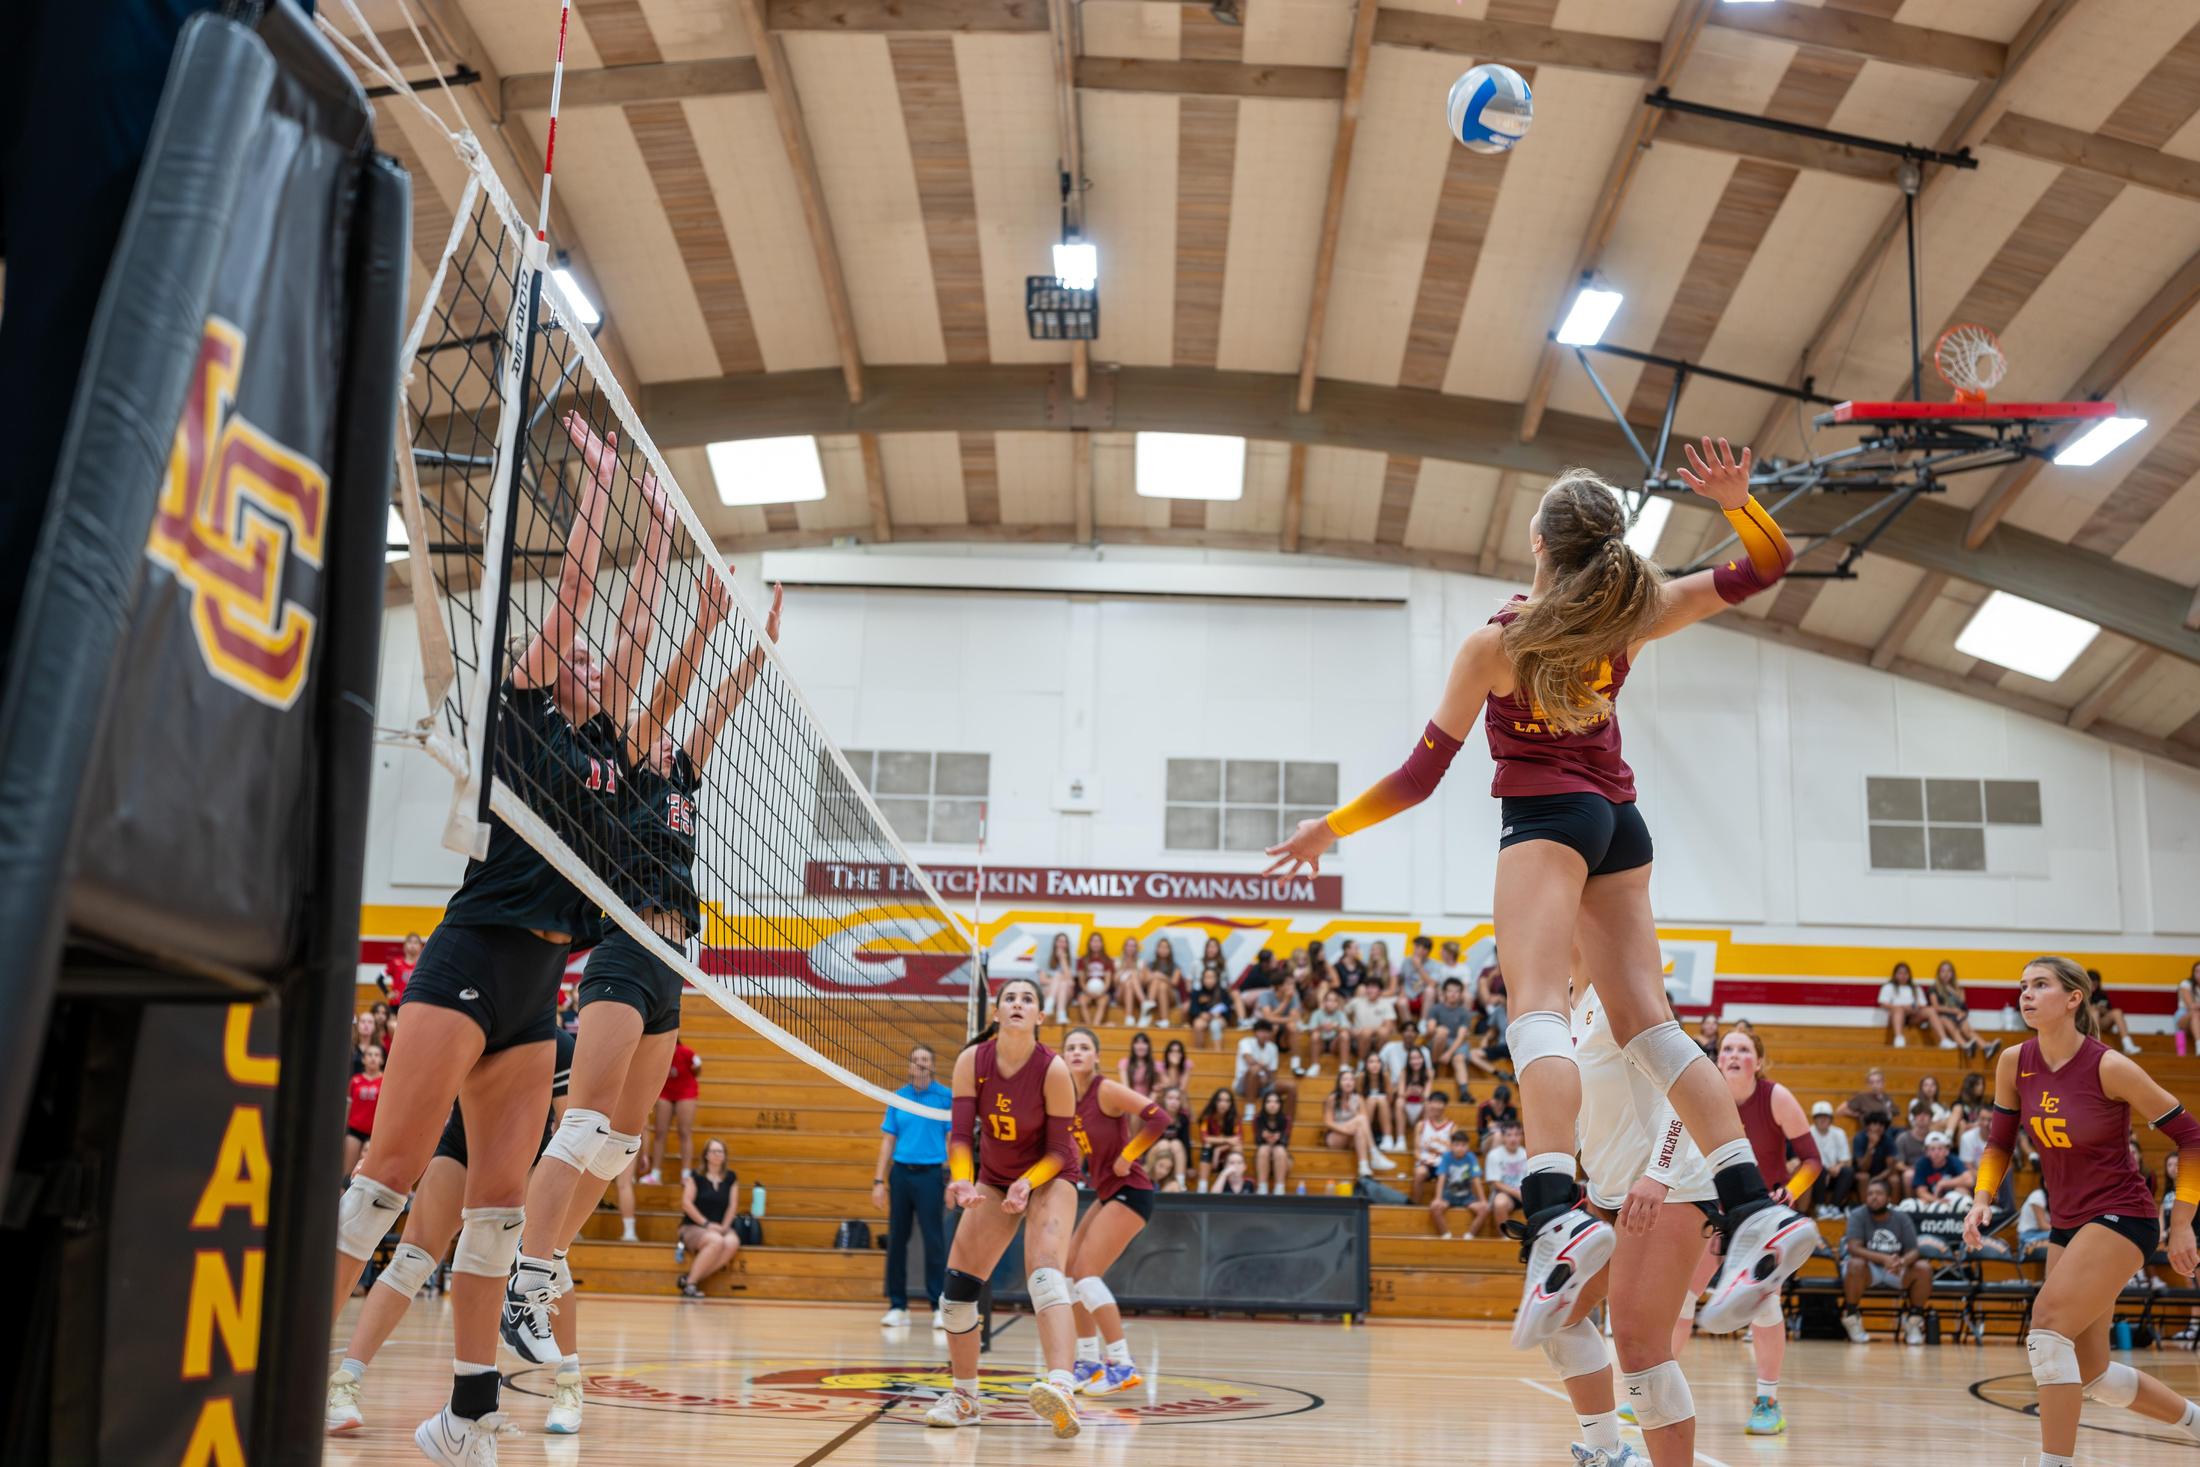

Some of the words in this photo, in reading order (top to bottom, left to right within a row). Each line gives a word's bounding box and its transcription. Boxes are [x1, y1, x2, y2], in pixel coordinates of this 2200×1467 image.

[826, 864, 881, 890] THE
[1046, 870, 1139, 896] FAMILY
[1145, 873, 1316, 901] GYMNASIUM
[988, 1113, 1016, 1141] 13
[2030, 1116, 2073, 1148] 16
[1658, 1119, 1683, 1169] SPARTANS
[1920, 1217, 1965, 1233] molte
